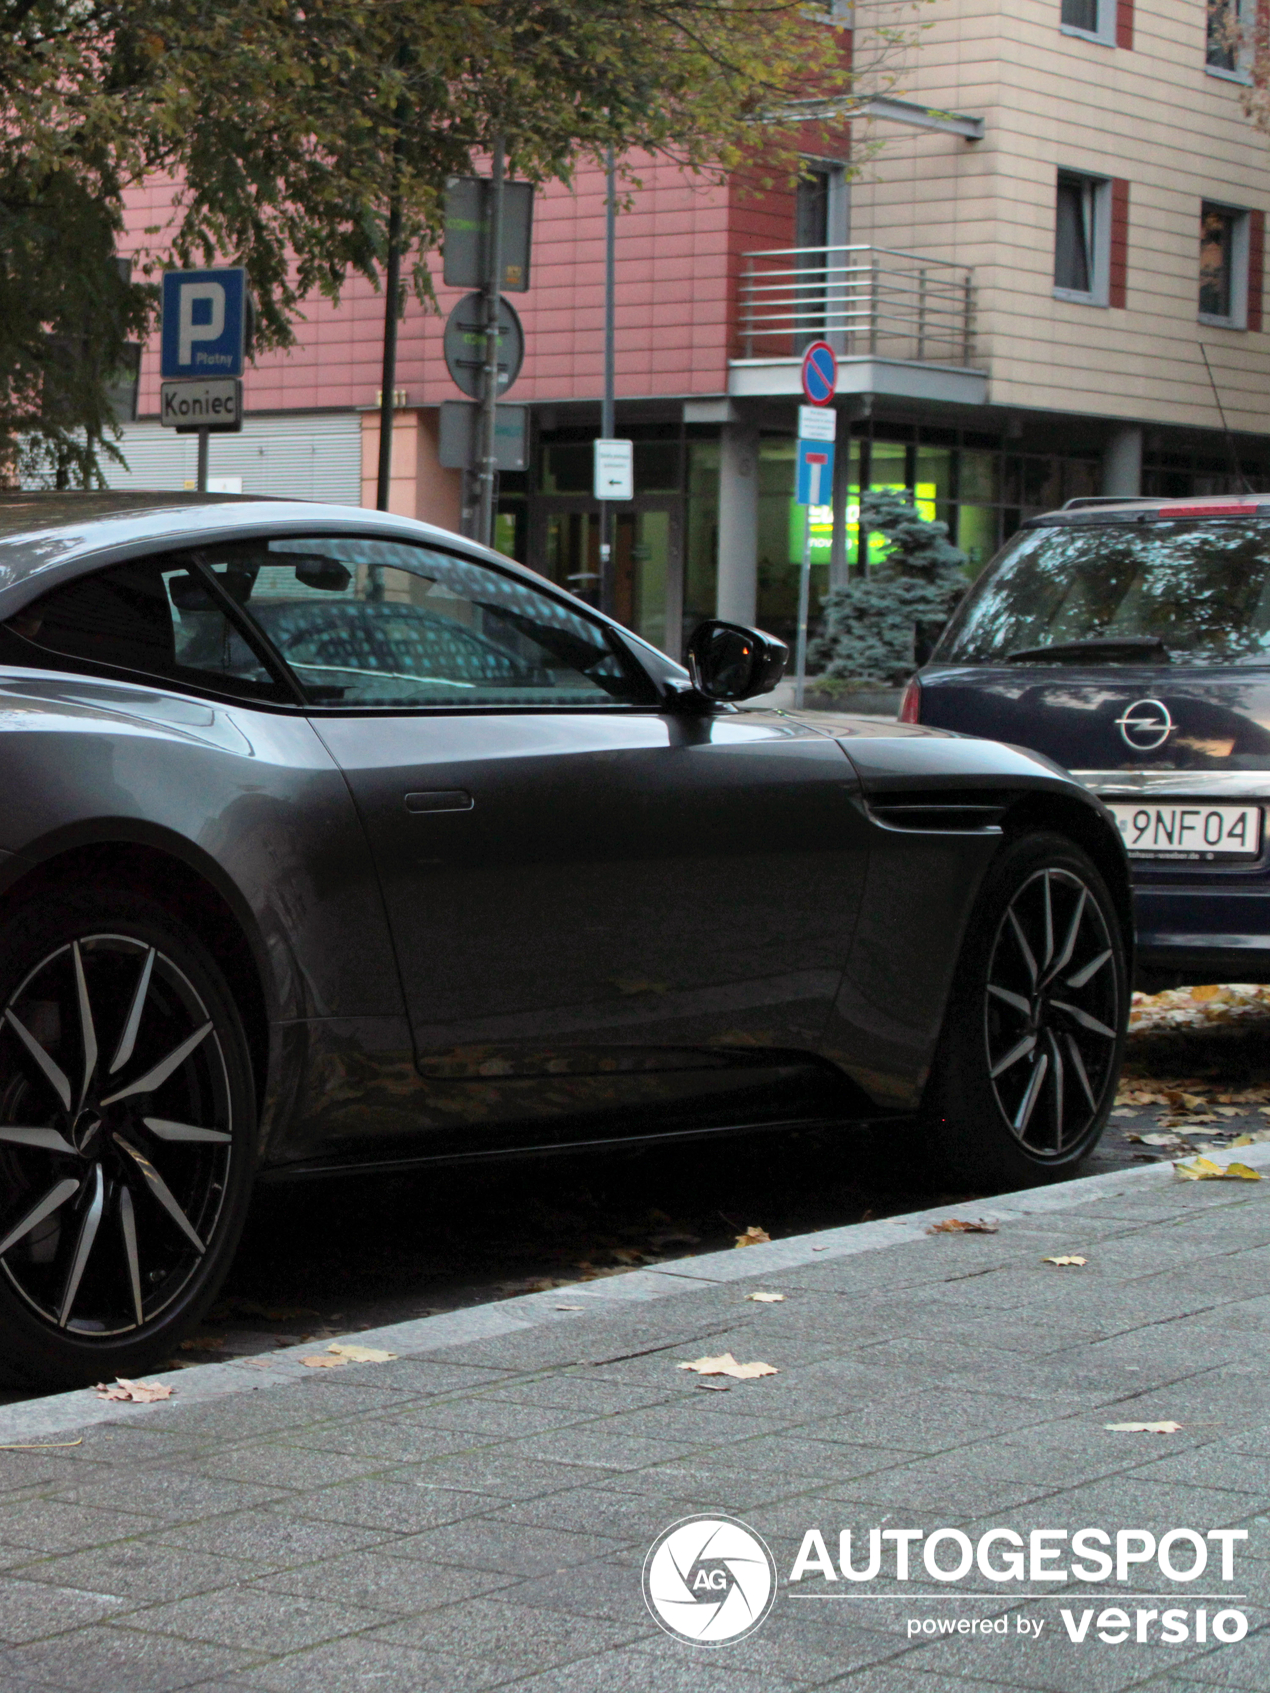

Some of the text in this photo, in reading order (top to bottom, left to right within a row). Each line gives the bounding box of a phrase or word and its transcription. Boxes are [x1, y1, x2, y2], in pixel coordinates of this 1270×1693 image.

[179, 282, 225, 365] P
[165, 391, 234, 416] Koniec
[1132, 810, 1247, 846] 9NF04
